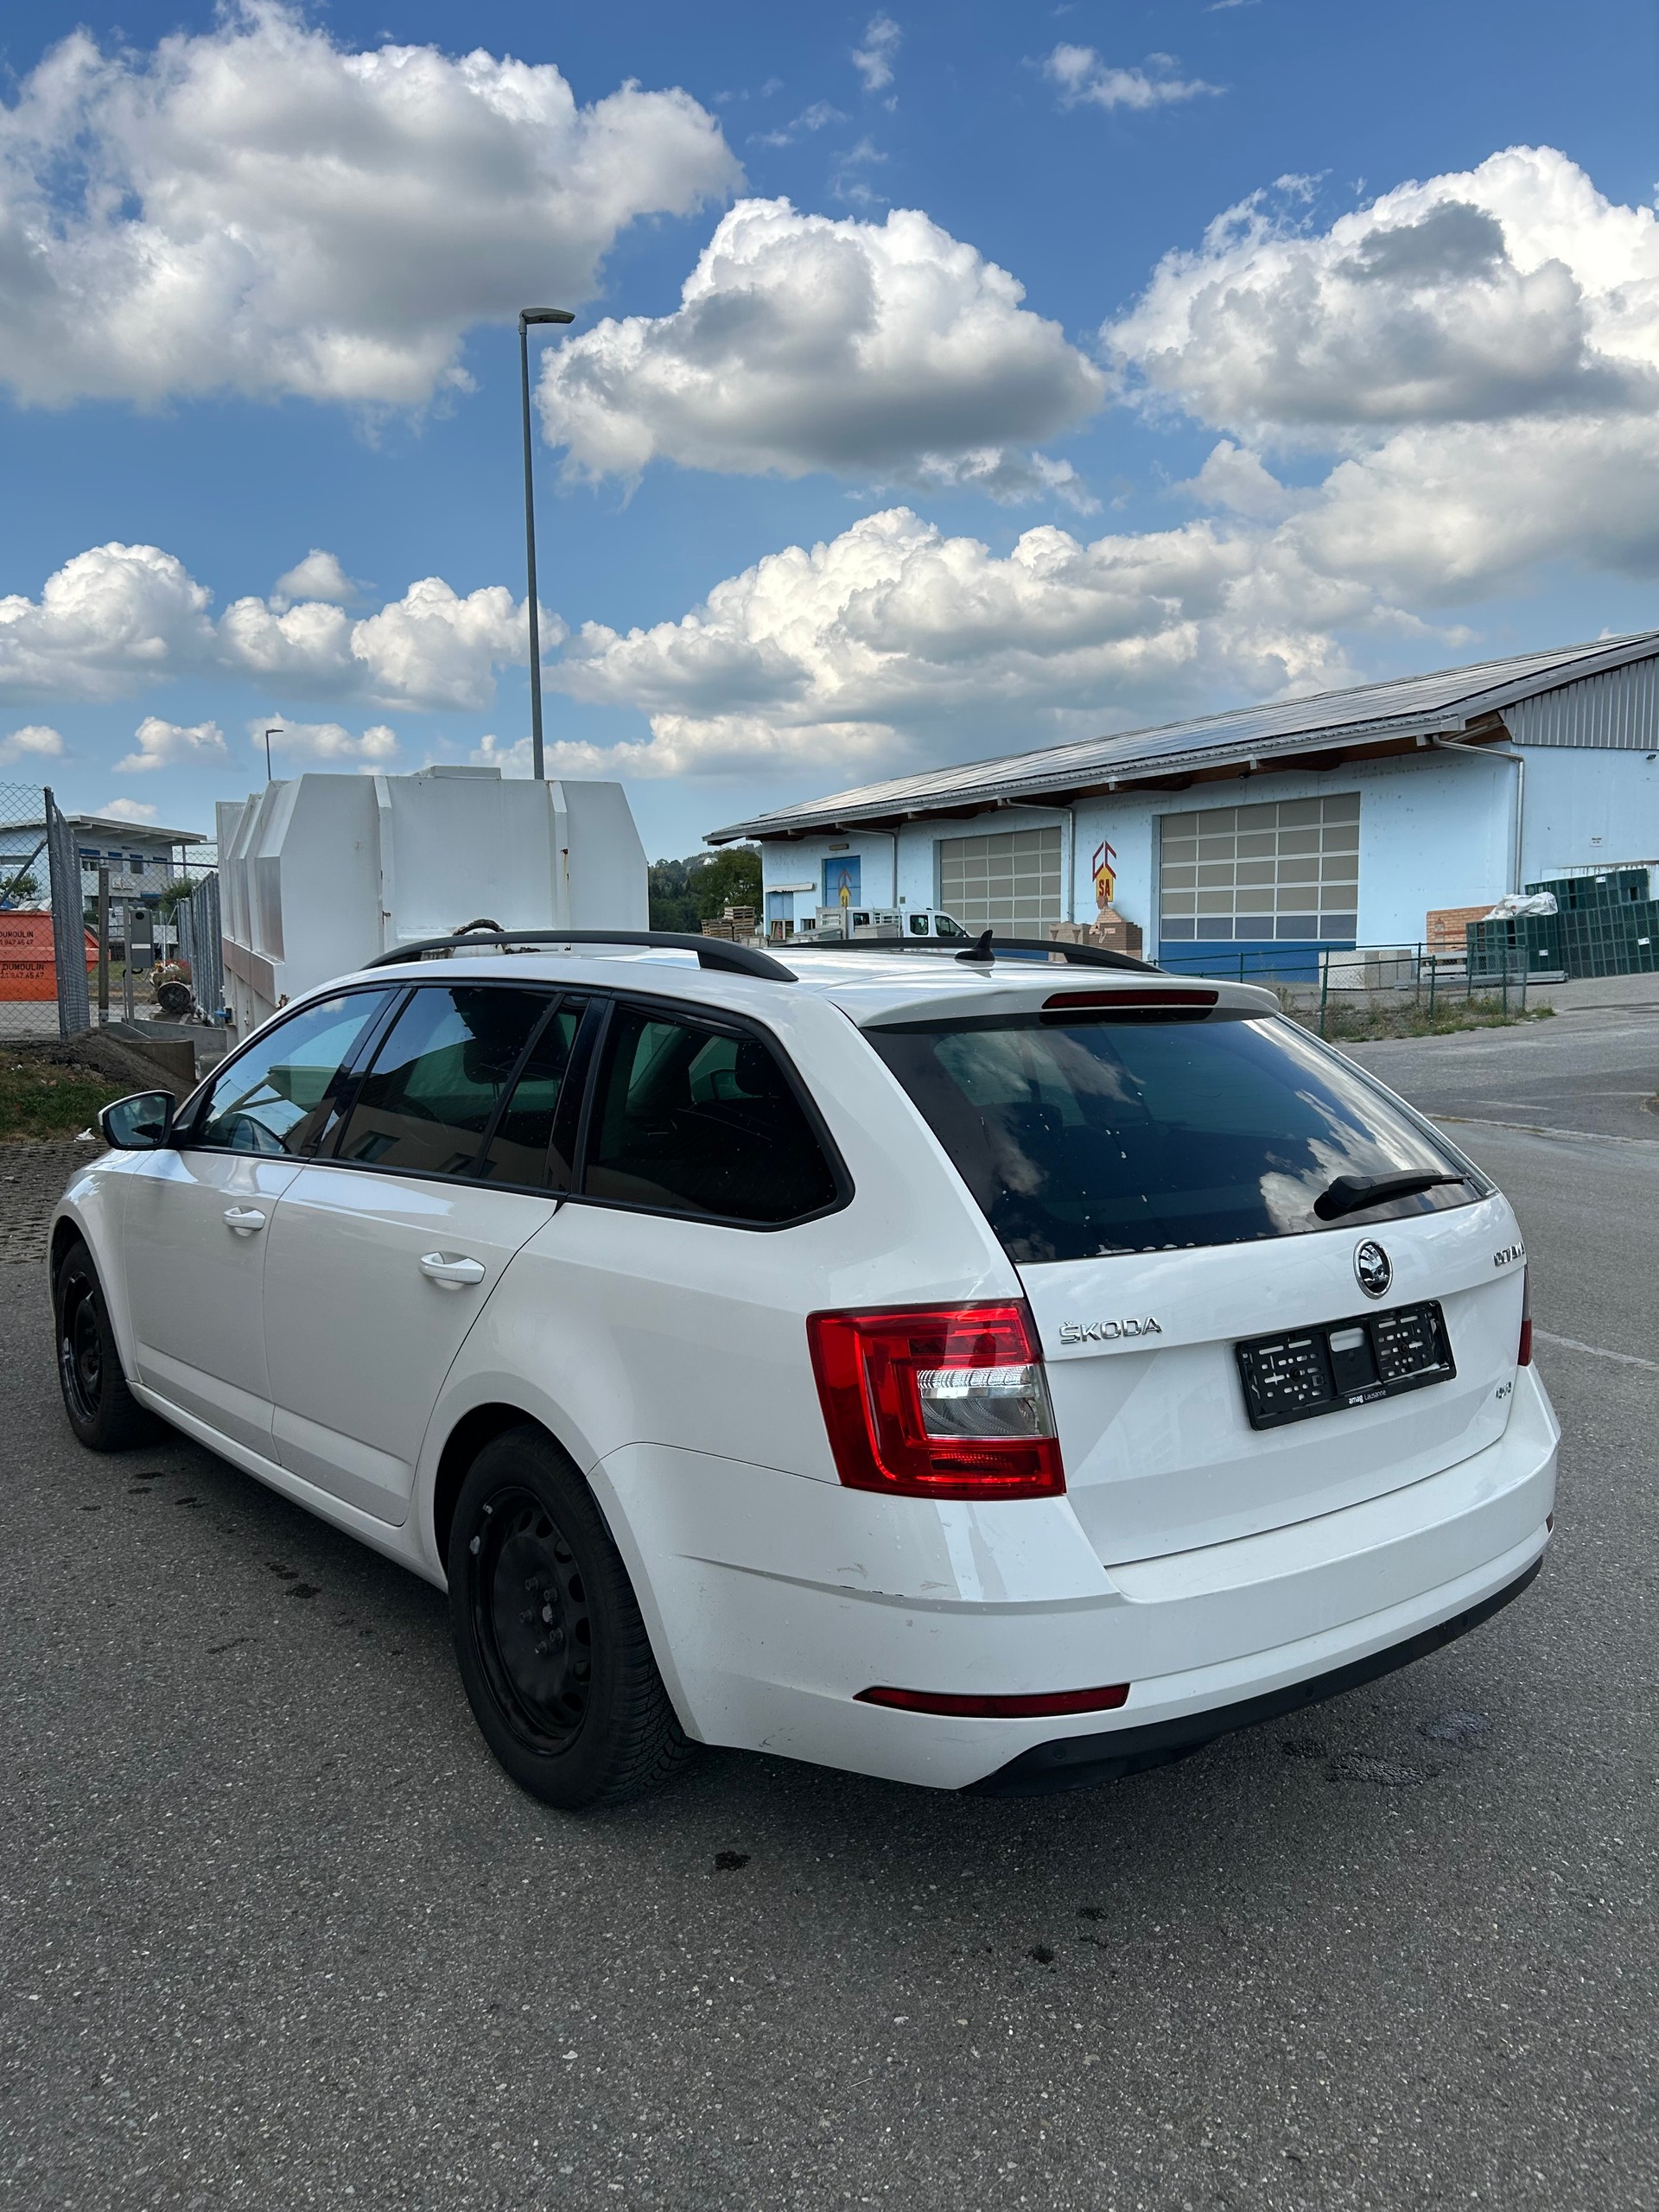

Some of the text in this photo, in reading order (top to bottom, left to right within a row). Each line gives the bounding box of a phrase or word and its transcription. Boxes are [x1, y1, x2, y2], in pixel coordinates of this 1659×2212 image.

[1098, 879, 1110, 897] SA
[1059, 1316, 1162, 1344] ŠKODA
[1349, 1390, 1386, 1404] amag Lausanne
